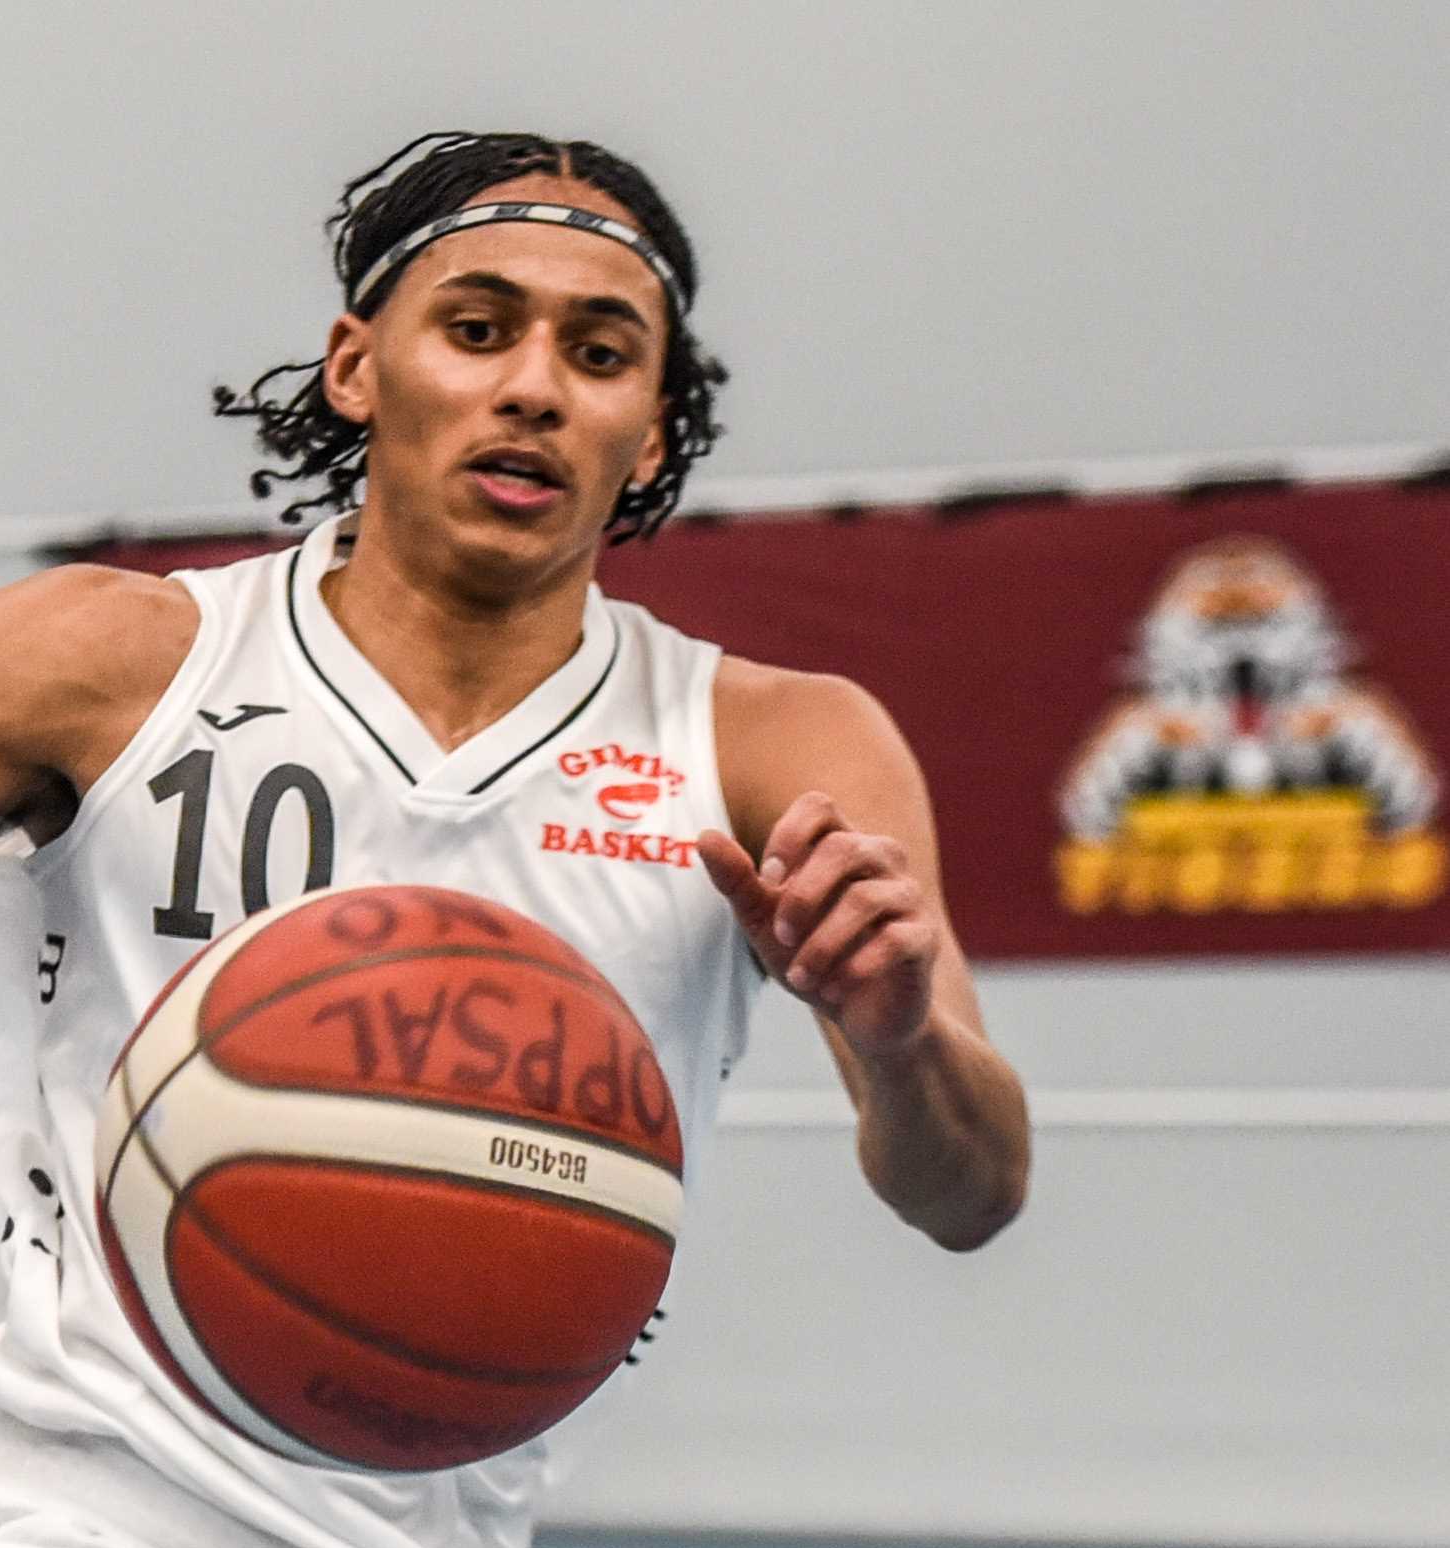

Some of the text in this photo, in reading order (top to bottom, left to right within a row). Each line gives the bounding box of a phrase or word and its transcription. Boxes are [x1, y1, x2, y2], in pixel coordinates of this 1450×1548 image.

[146, 748, 337, 940] 10
[310, 976, 672, 1138] OPPSAL
[489, 1135, 589, 1184] BG4500
